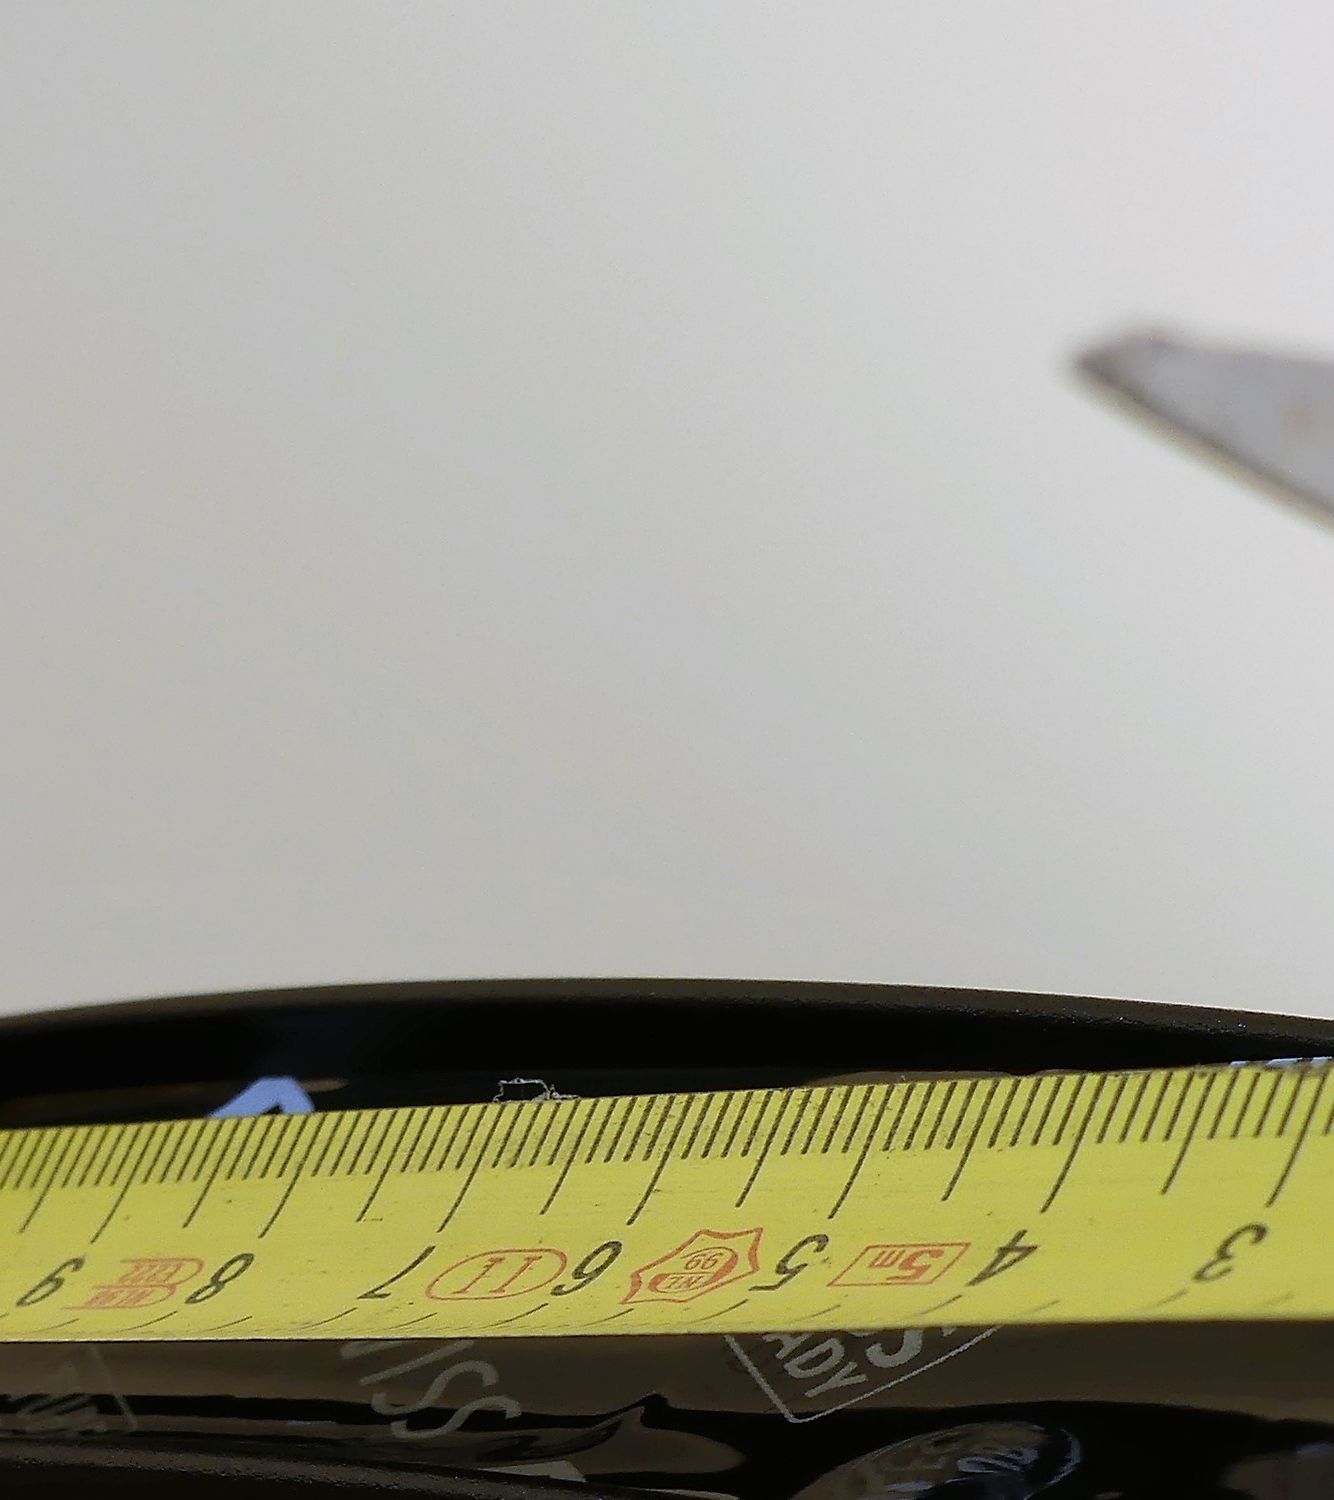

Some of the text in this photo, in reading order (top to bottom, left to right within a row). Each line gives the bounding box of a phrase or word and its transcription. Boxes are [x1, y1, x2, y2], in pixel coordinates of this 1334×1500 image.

[185, 1253, 256, 1305] 8
[357, 1246, 436, 1299] 7
[550, 1241, 623, 1297] 6
[748, 1233, 830, 1293] 5
[967, 1229, 1038, 1287] 4
[1193, 1223, 1268, 1283] 3
[15, 1258, 85, 1307] 9
